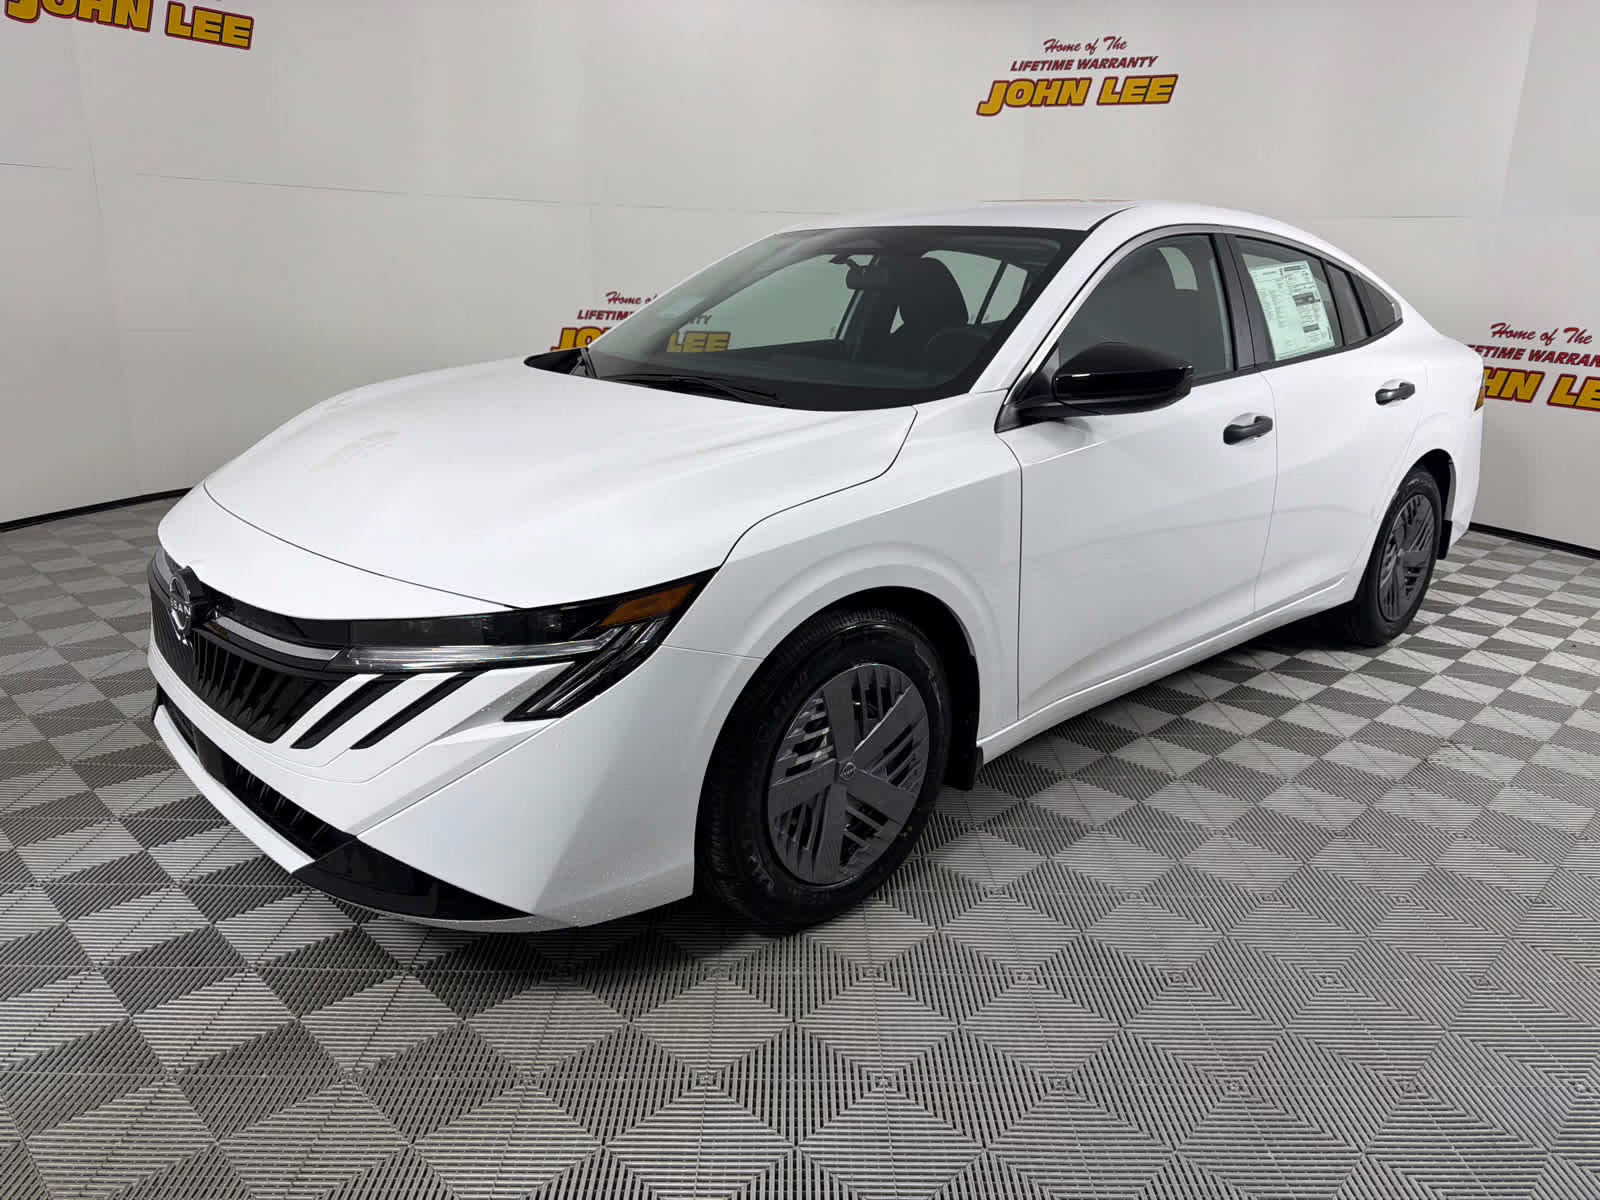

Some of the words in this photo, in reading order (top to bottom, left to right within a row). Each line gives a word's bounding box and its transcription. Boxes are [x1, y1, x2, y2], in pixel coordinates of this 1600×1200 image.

[164, 1, 255, 50] LEE
[1043, 38, 1081, 53] Home
[1084, 38, 1099, 55] of
[1103, 36, 1128, 51] The
[1010, 59, 1075, 72] LIFETIME
[1076, 55, 1159, 71] WARRANTY
[976, 77, 1093, 117] JOHN
[1096, 74, 1179, 106] LEE
[605, 291, 641, 305] Home
[664, 331, 731, 353] LEE
[1490, 322, 1537, 341] Home
[1540, 328, 1559, 346] of
[1563, 327, 1593, 345] The
[1528, 349, 1600, 368] WARRAN
[1483, 366, 1545, 403] HN
[1547, 373, 1600, 412] LE
